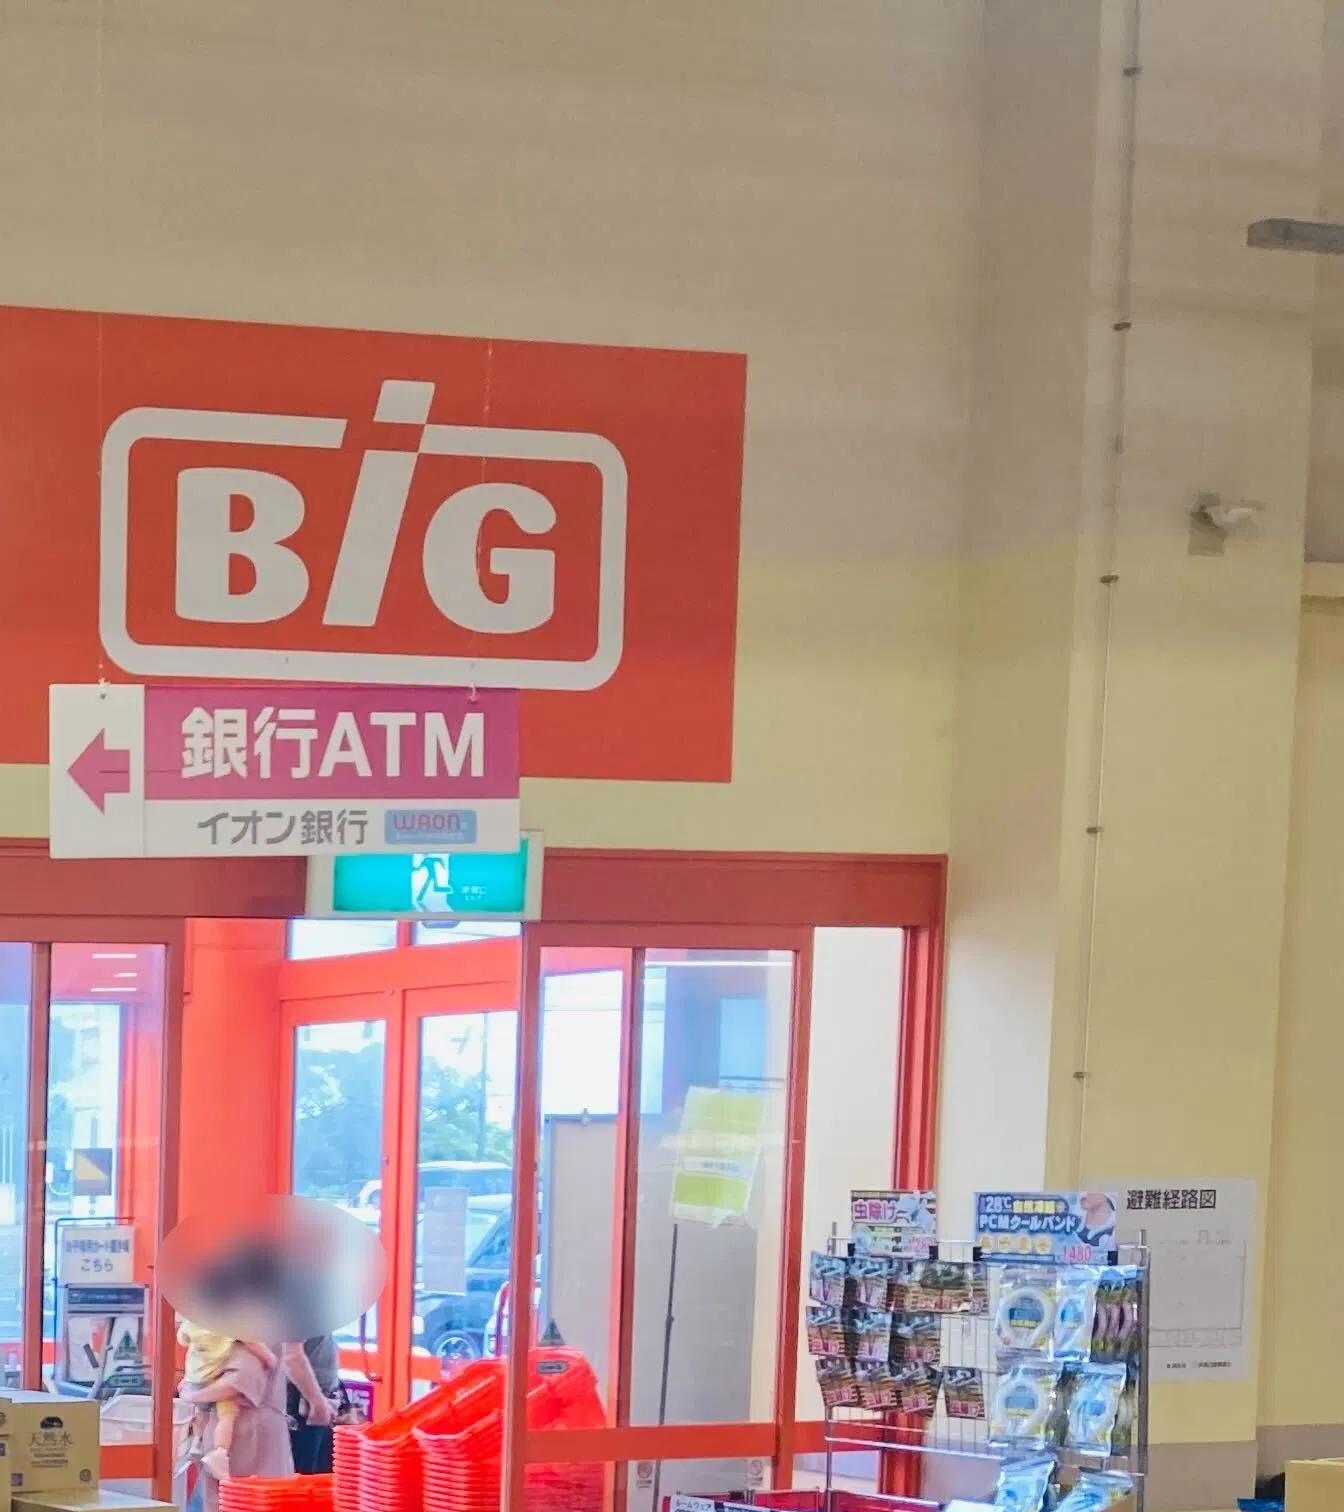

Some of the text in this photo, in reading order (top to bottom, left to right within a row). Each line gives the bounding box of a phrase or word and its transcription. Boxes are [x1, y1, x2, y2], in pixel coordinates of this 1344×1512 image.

[181, 706, 485, 781] 銀行ATM
[196, 809, 369, 846] イオン銀行
[392, 813, 460, 832] WAON
[1126, 1189, 1217, 1210] 避難経路図
